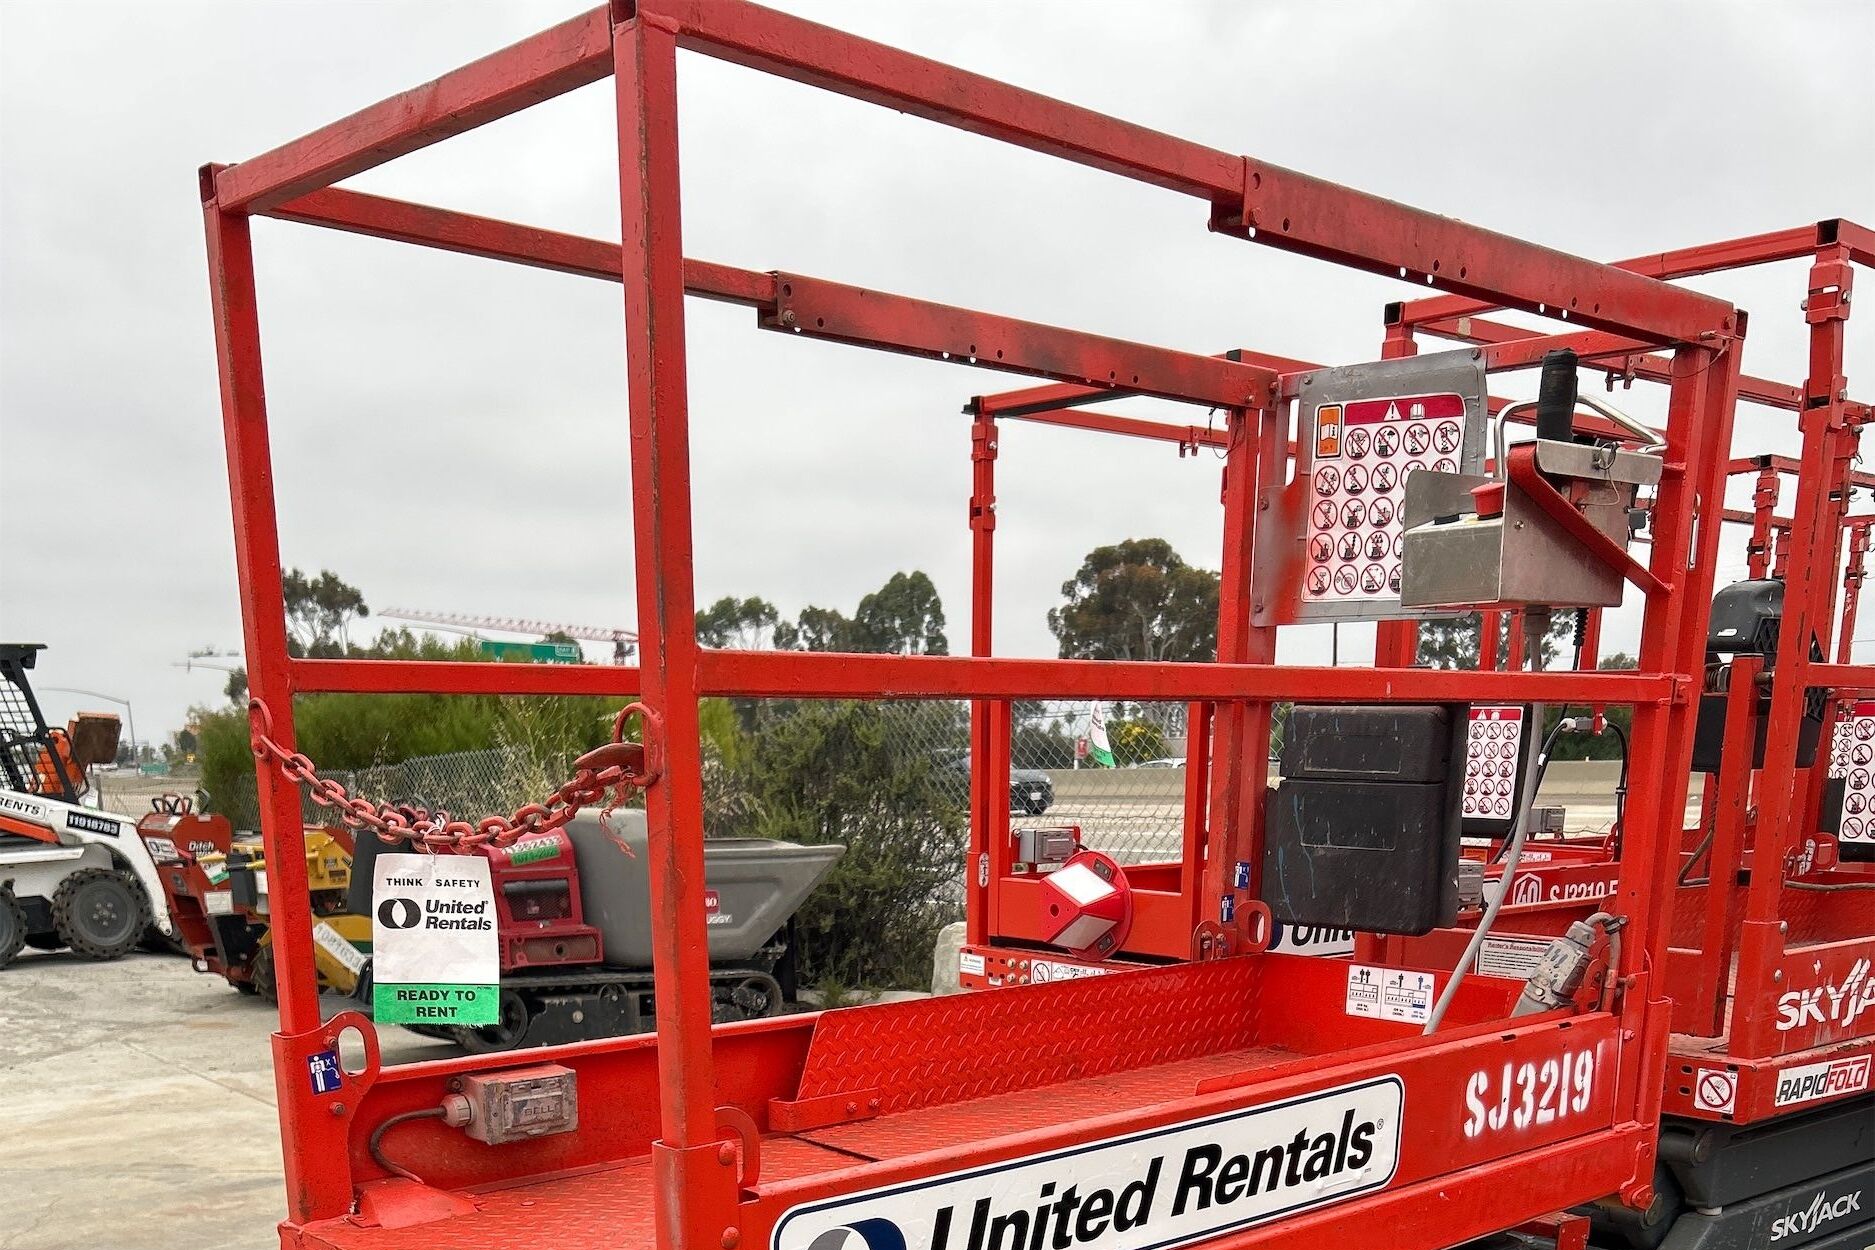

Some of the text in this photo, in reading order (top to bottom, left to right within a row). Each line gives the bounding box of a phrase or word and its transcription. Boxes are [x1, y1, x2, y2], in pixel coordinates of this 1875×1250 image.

[386, 878, 480, 888] THINK SAFETY
[425, 899, 485, 915] United
[425, 916, 492, 930] Rentals
[397, 990, 476, 1001] READY TO
[416, 1007, 458, 1018] RENT
[1463, 1050, 1593, 1138] SJ3219
[1171, 1109, 1376, 1217] Rentals
[1770, 1190, 1862, 1241] SKYJACK
